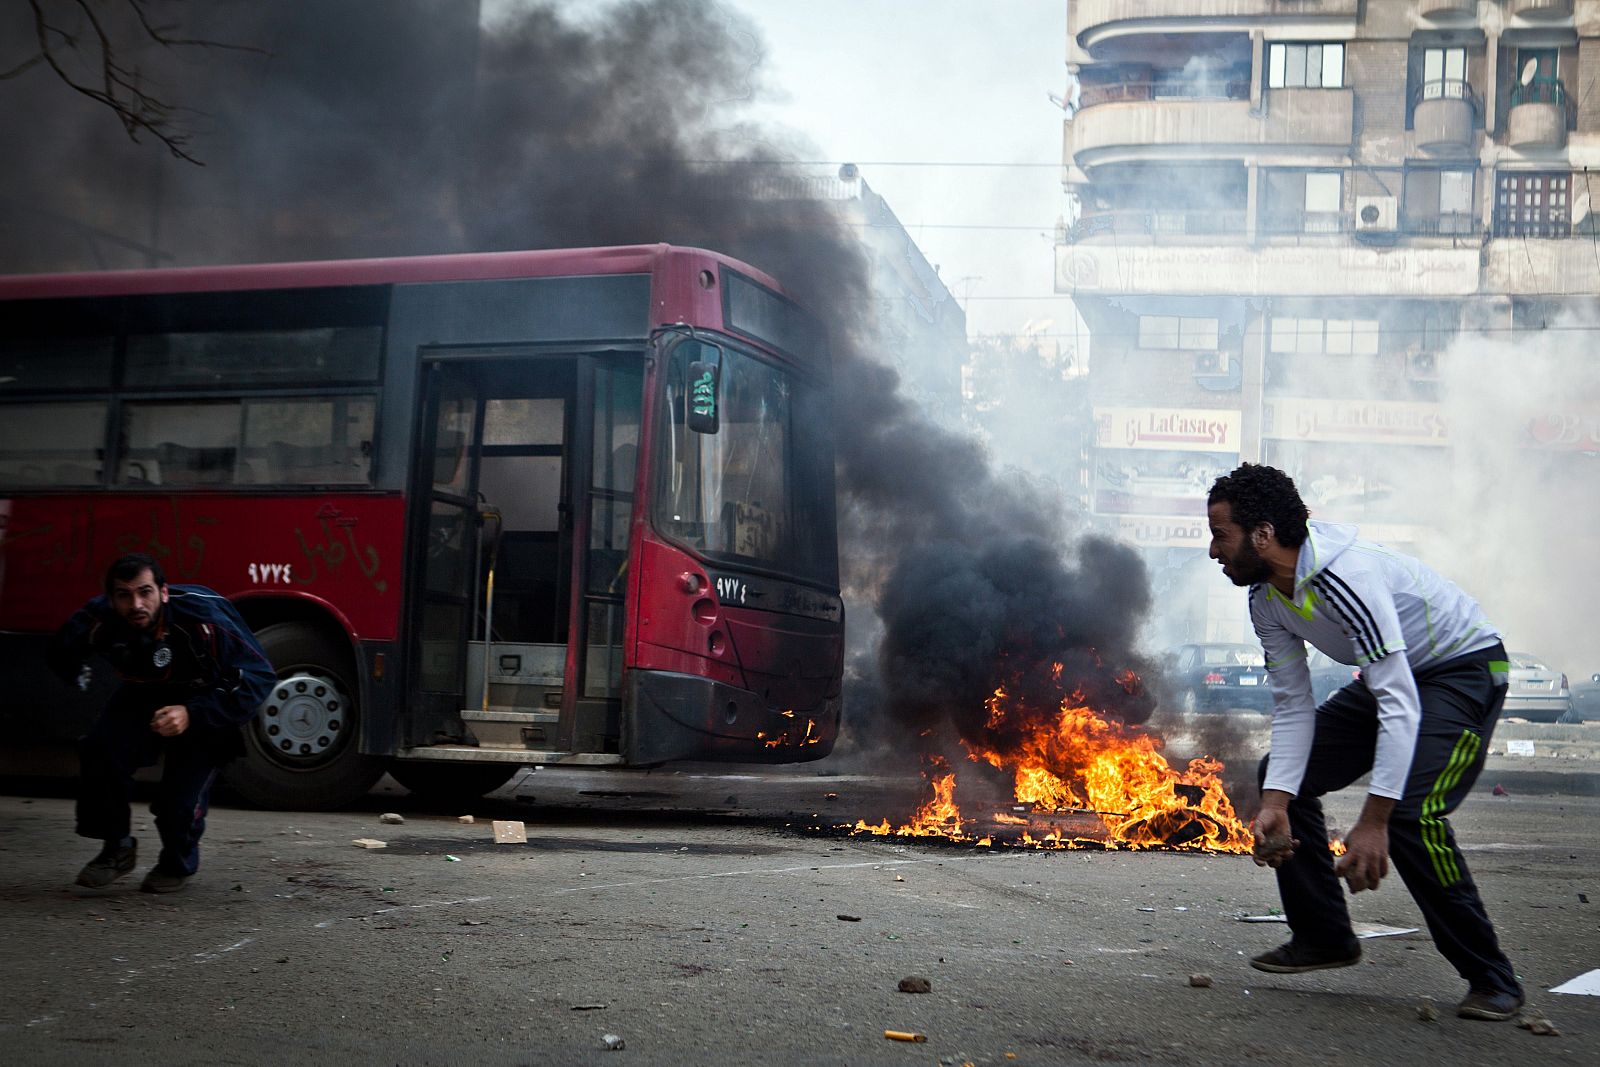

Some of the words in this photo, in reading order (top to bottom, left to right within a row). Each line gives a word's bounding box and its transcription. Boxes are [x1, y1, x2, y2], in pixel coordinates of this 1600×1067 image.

[1149, 412, 1208, 433] LaCasa
[247, 562, 293, 585] ٩٧٧٤
[716, 577, 748, 605] ٩٧٧٤
